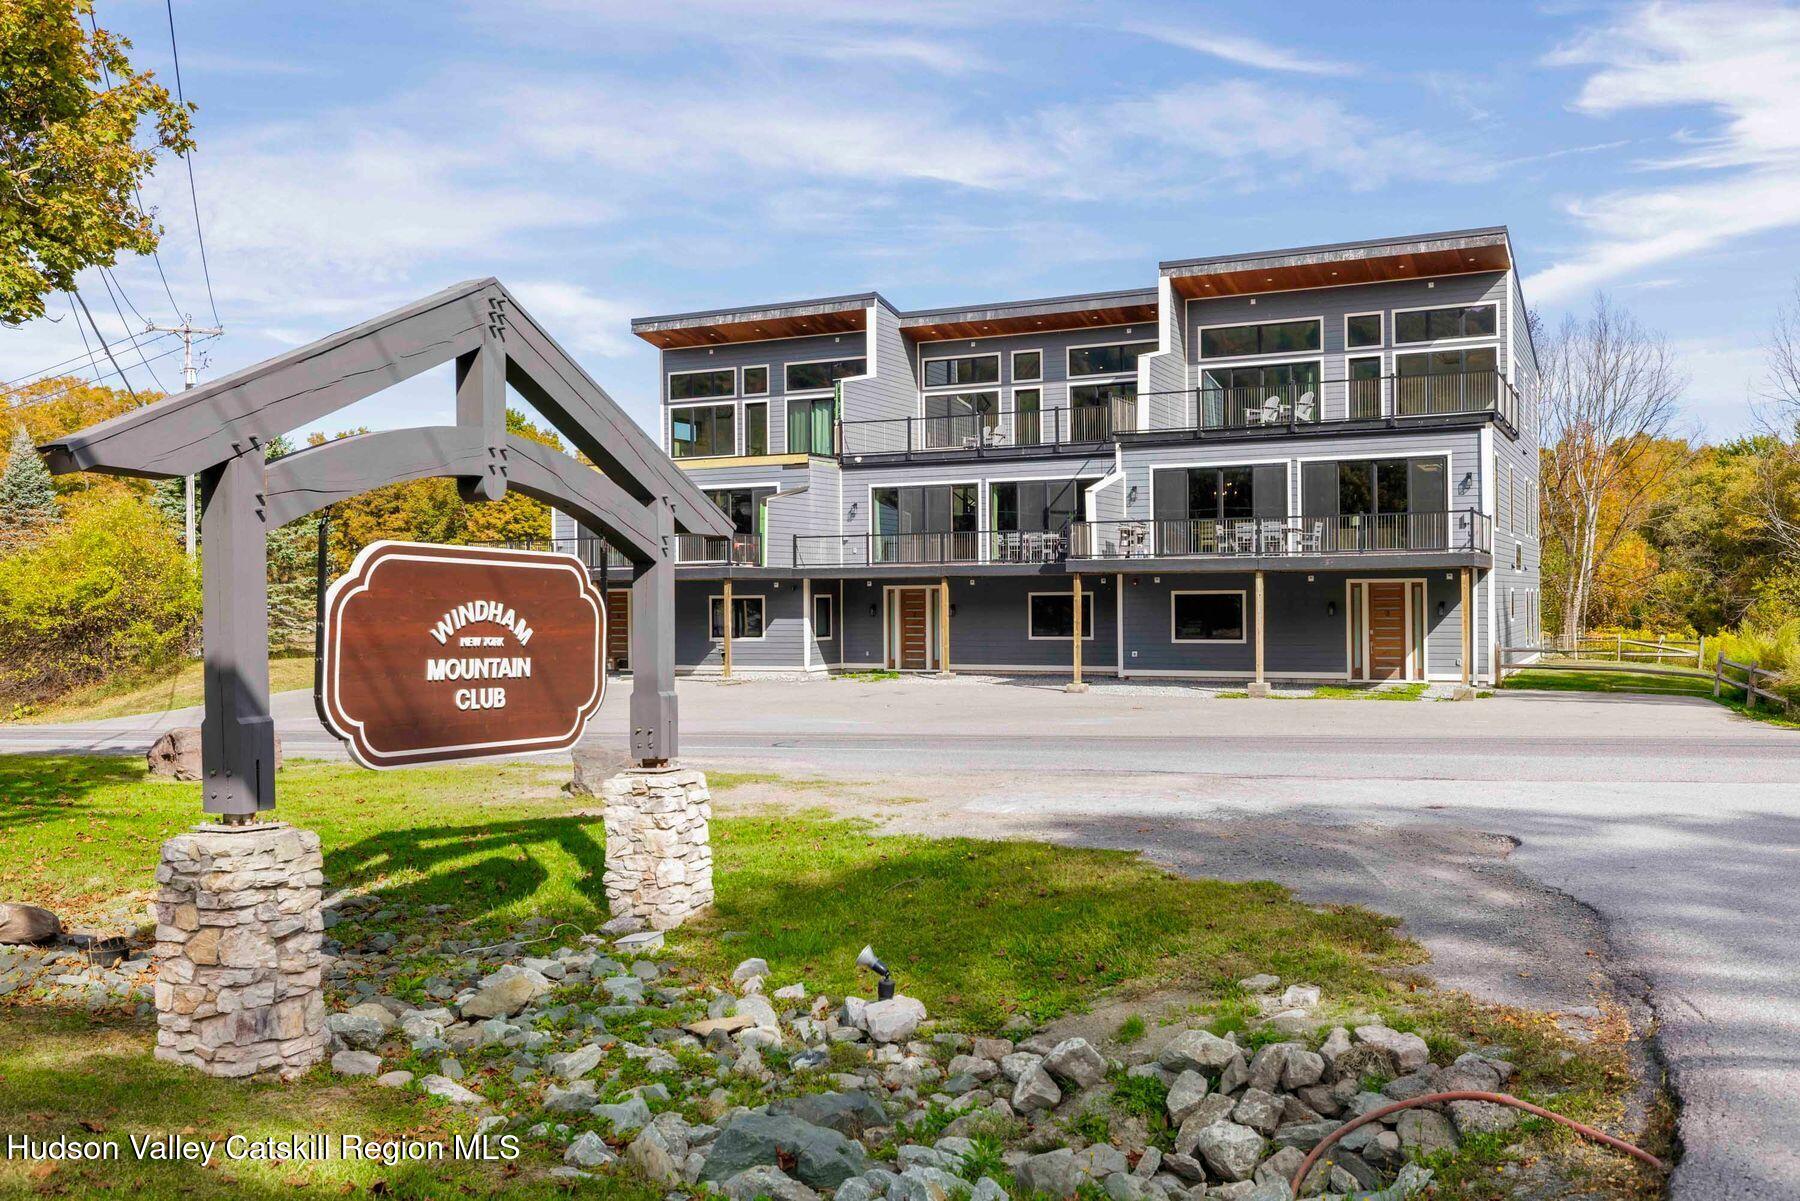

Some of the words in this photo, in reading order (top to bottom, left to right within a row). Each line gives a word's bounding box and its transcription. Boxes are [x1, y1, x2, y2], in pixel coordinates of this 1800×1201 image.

[430, 600, 534, 646] WINDHAM
[459, 636, 481, 647] NEW
[426, 657, 531, 681] MOUNTAIN
[455, 687, 506, 710] CLUB
